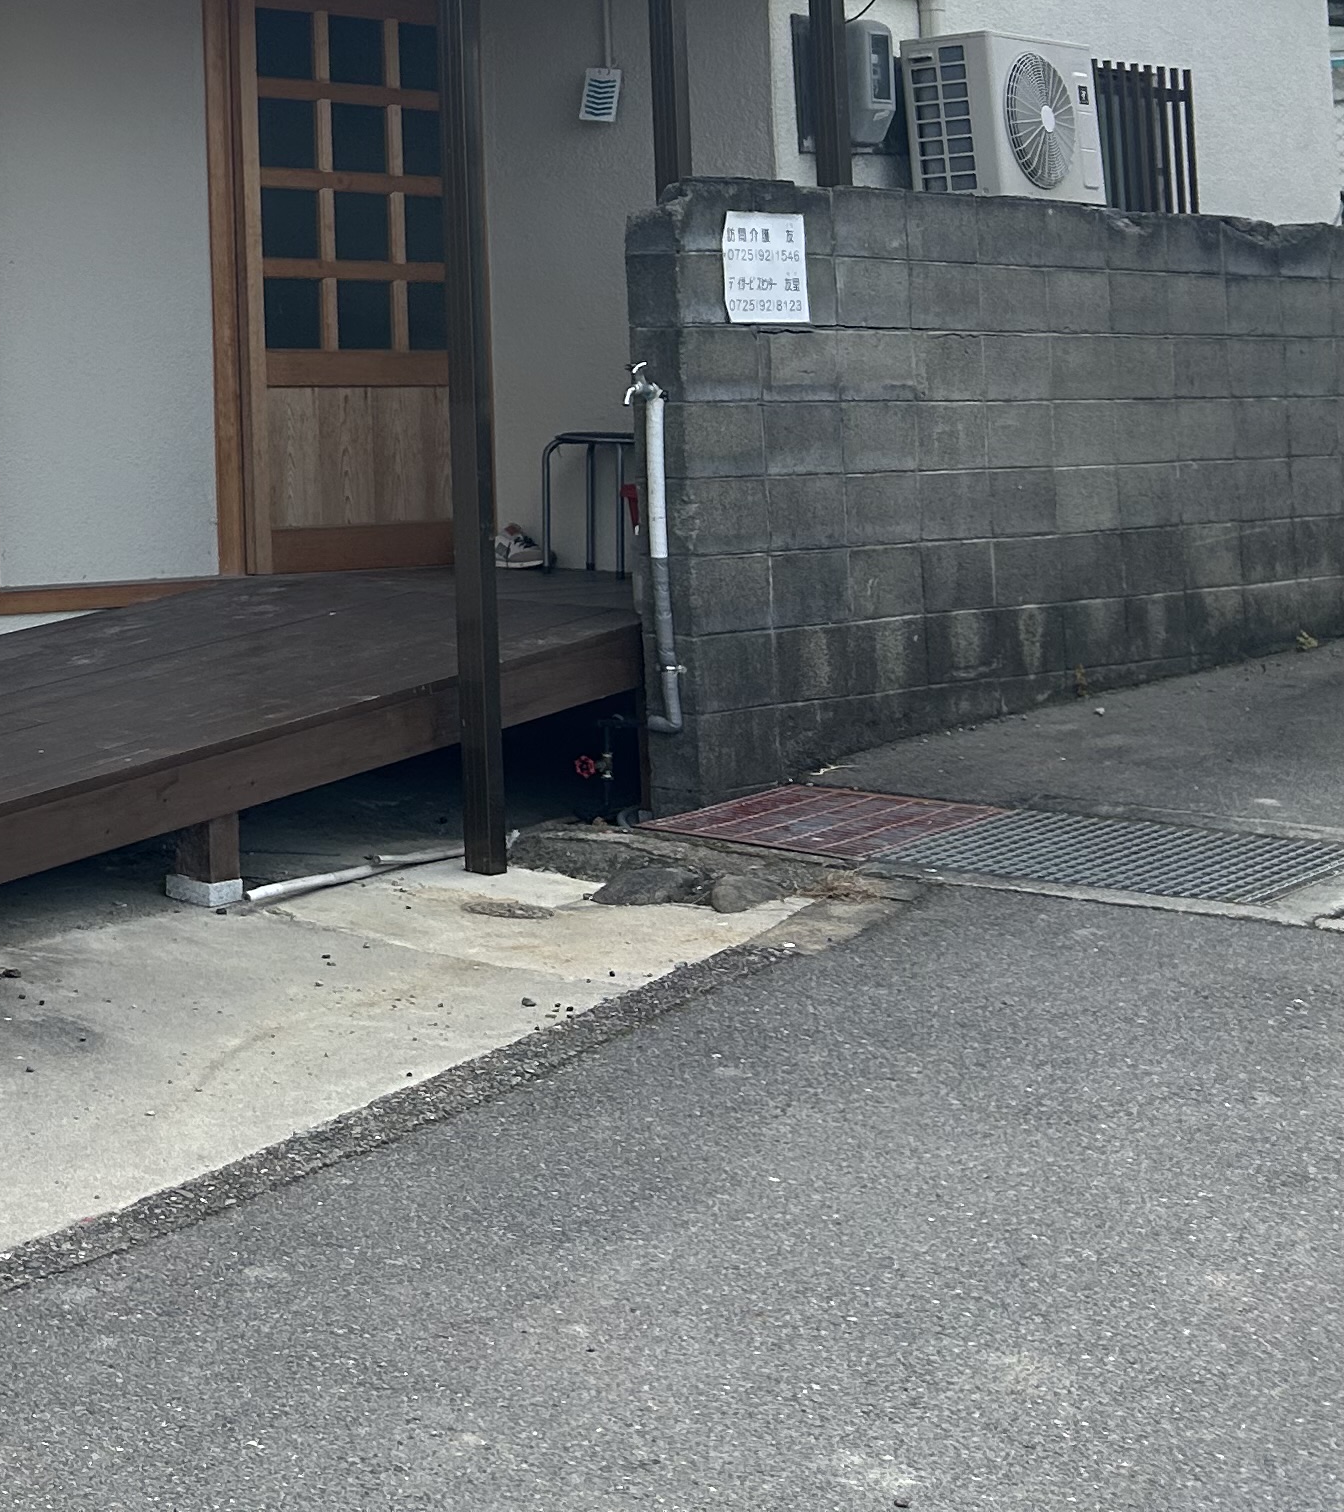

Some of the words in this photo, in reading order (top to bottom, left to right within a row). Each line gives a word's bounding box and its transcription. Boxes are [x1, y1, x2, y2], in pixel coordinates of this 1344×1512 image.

[726, 227, 771, 243] 訪問介護
[727, 248, 800, 263] 0725(92)1546
[729, 298, 803, 313] 0725(92)8123
